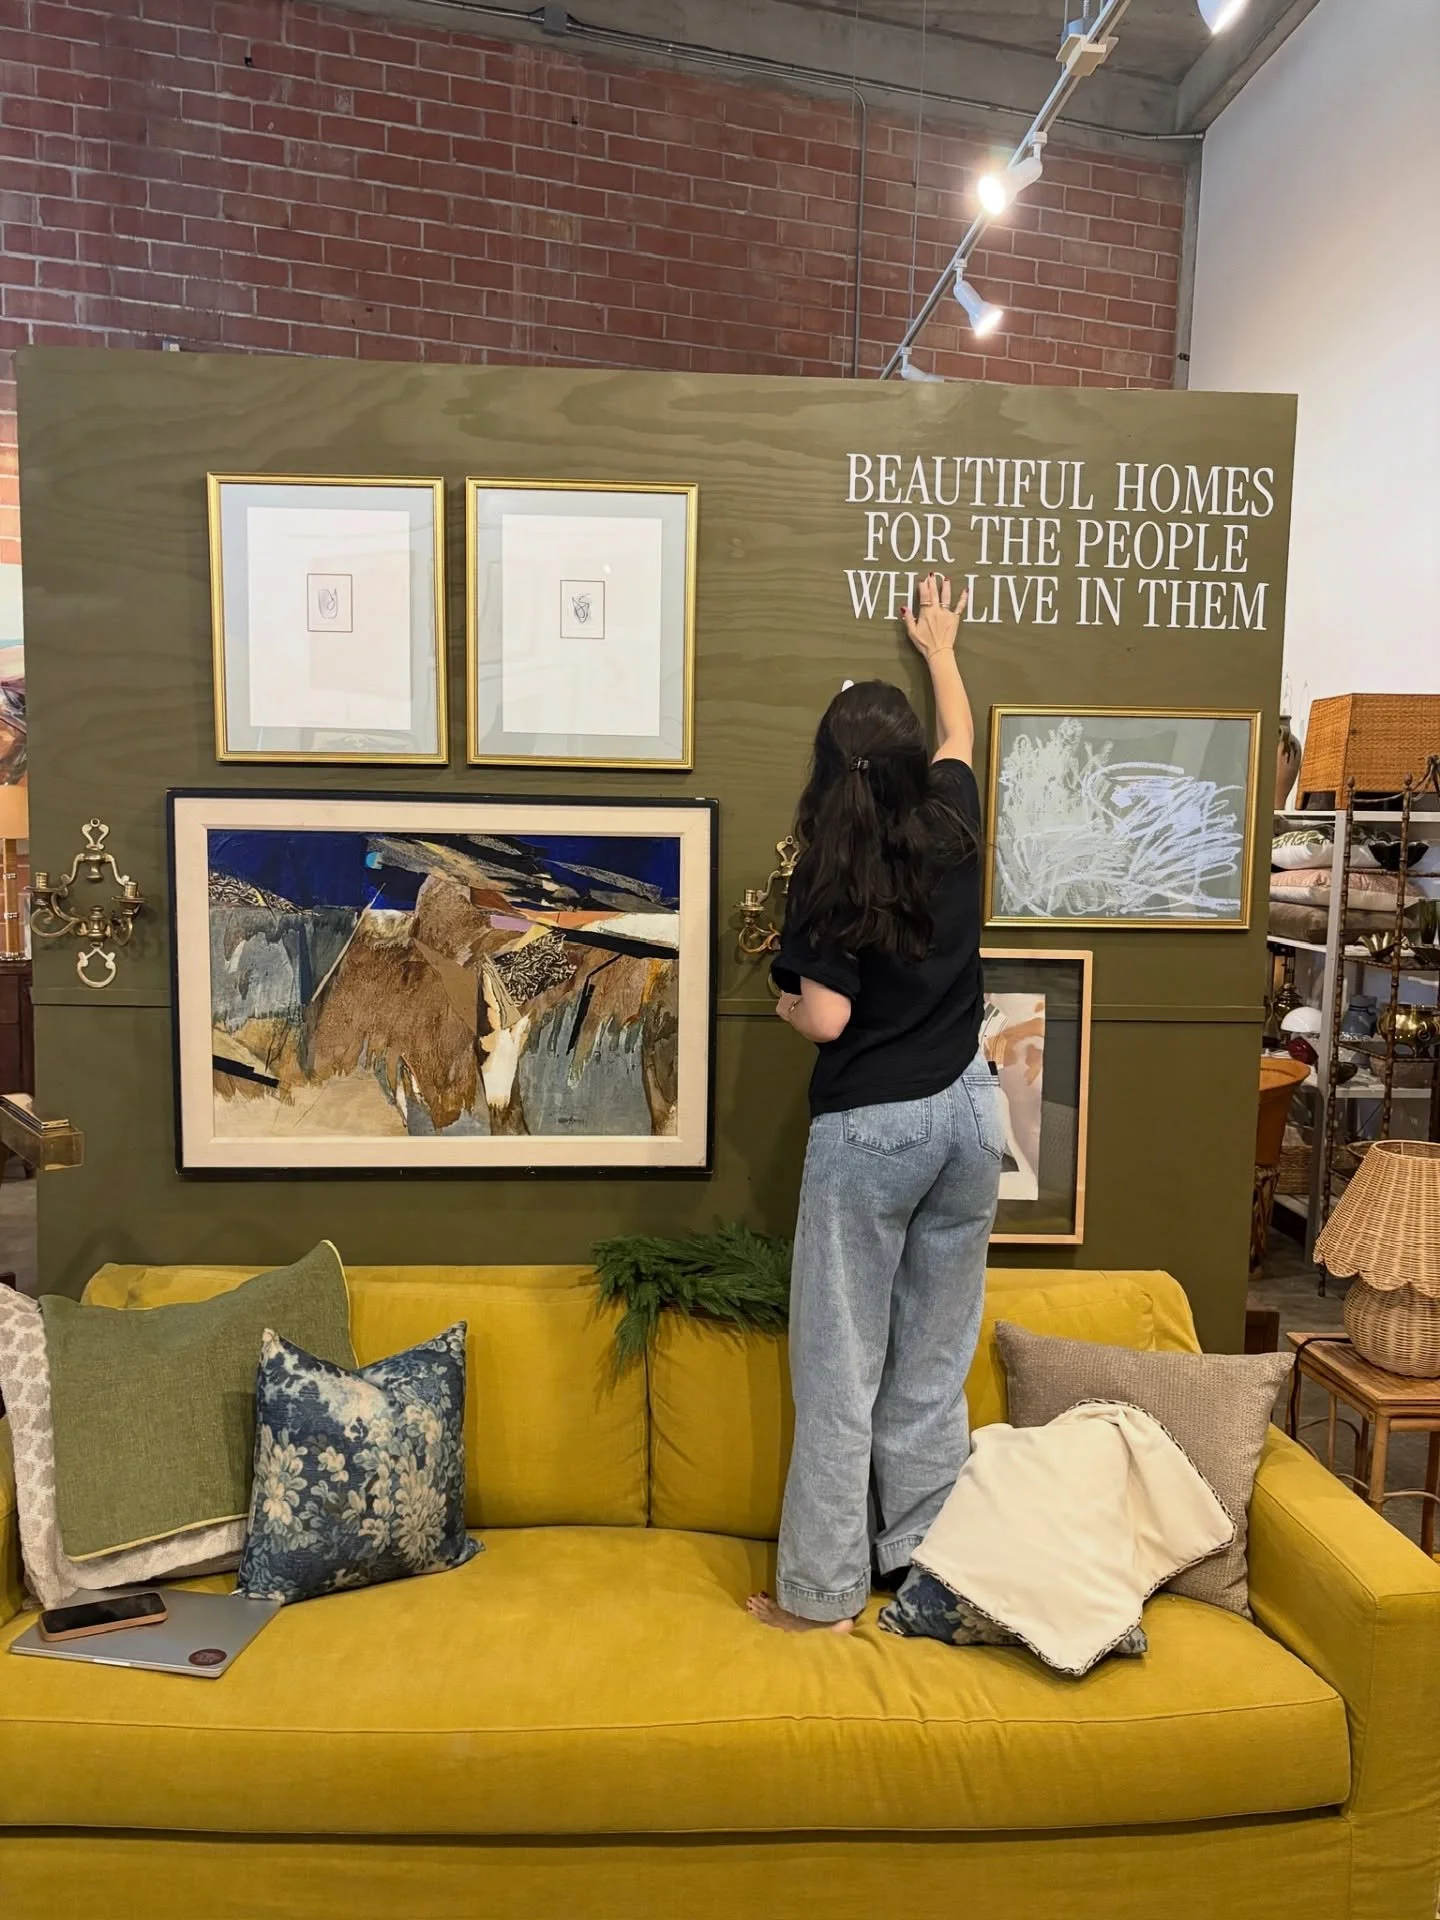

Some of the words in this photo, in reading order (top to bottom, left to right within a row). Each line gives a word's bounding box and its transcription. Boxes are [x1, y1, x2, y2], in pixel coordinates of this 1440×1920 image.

[845, 453, 1094, 510] BEAUTIFUL
[1114, 462, 1274, 517] HOMES
[863, 511, 955, 564] FOR
[970, 515, 1061, 566] THE
[1074, 519, 1249, 573] PEOPLE
[962, 574, 1059, 625] LIVE
[1075, 577, 1126, 626] IN
[1138, 578, 1270, 631] THEM
